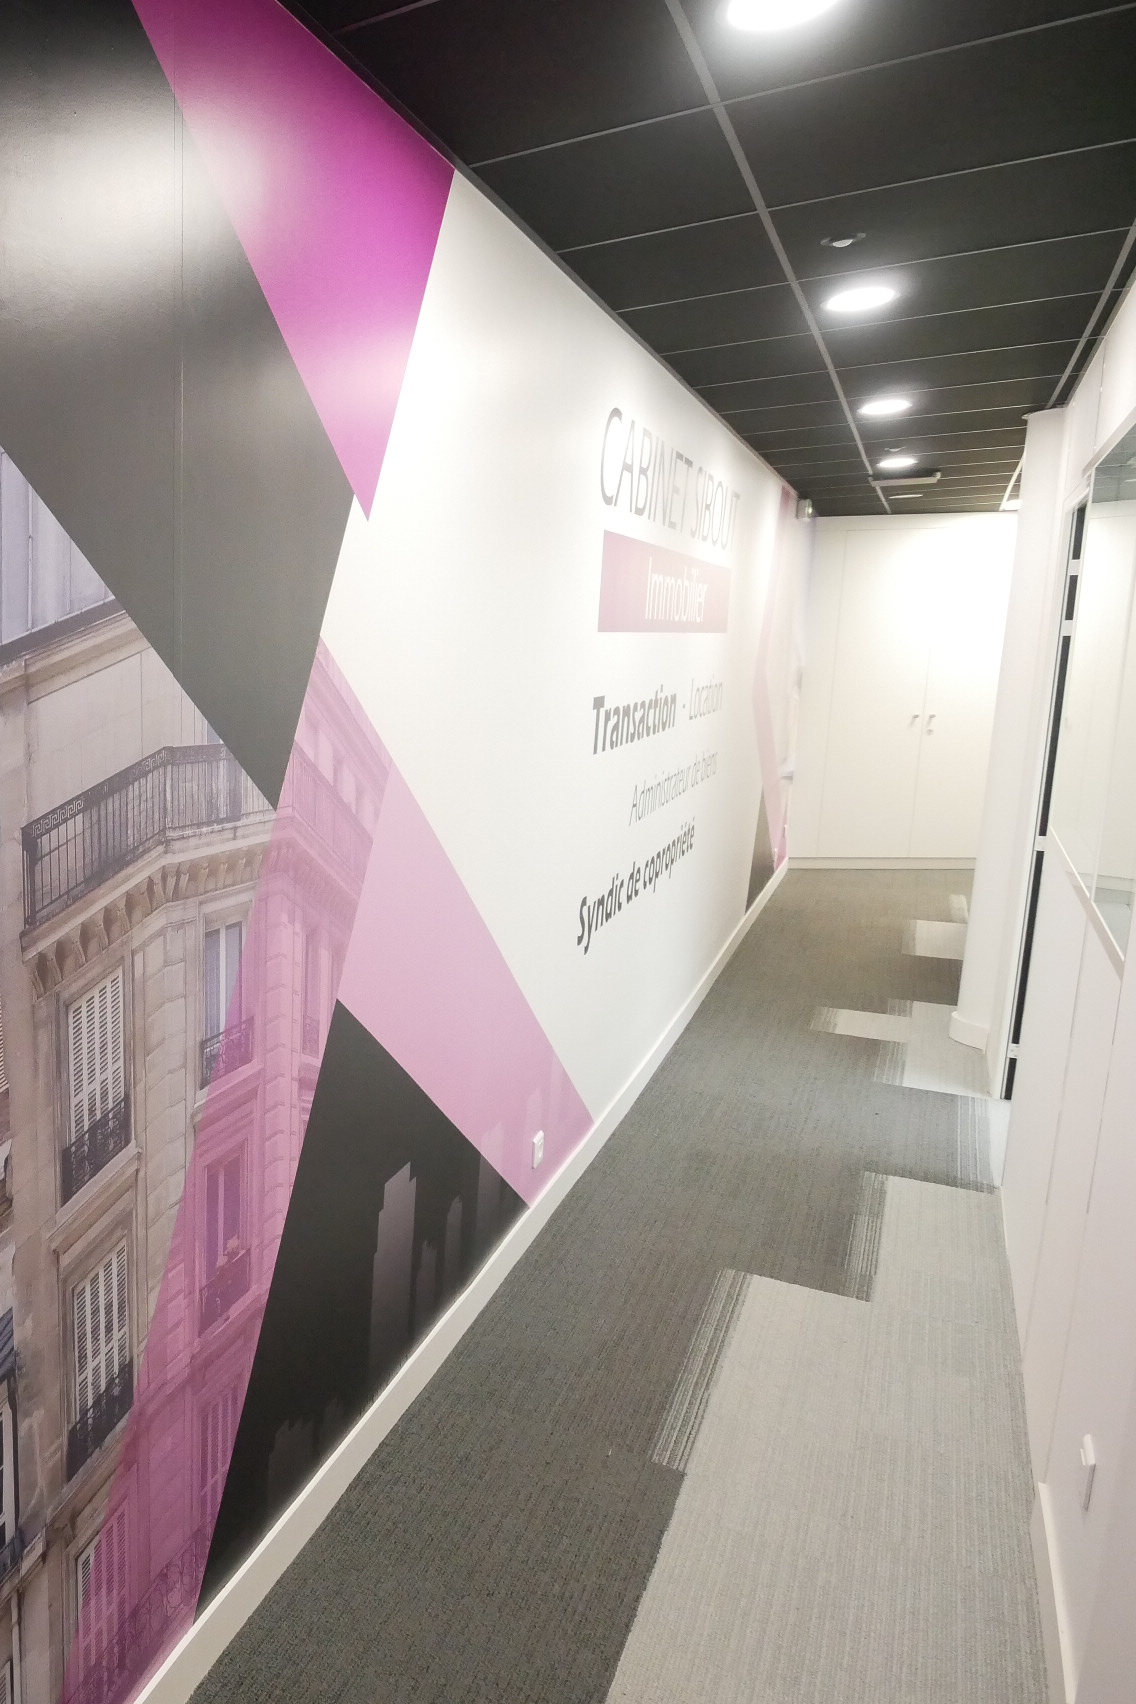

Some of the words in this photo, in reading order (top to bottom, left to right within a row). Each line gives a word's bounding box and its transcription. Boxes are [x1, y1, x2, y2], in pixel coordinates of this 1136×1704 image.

[600, 407, 693, 533] CABINET
[690, 465, 740, 551] SIBOUT
[645, 556, 708, 623] Immobilier
[593, 684, 677, 755] Transaction
[689, 674, 723, 720] Location
[629, 764, 691, 826] Administrateur
[691, 753, 701, 788] de
[577, 872, 624, 955] Syndic
[626, 861, 641, 904] de
[643, 816, 695, 893] copropriété
